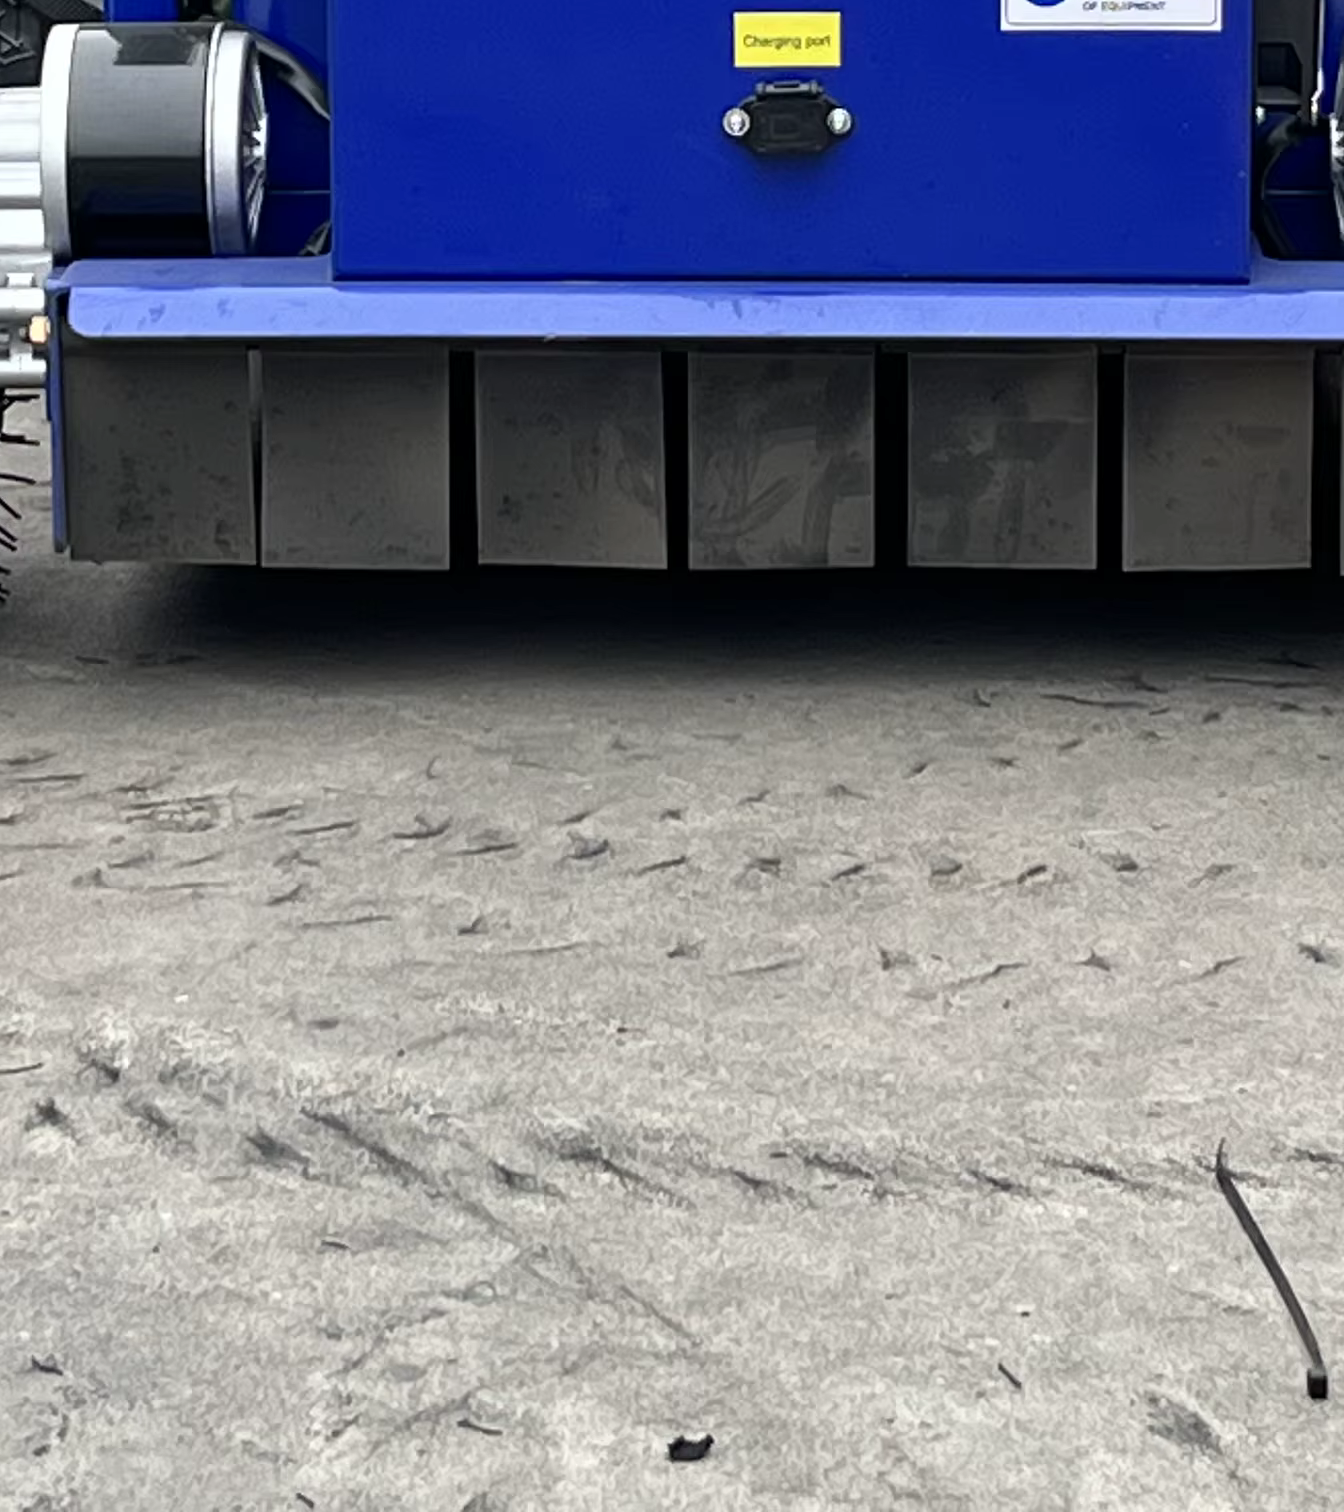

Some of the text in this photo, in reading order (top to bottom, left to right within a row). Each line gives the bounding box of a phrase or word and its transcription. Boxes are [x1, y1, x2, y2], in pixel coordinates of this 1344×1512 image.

[1083, 2, 1166, 11] OF EQUIPMENT
[743, 35, 831, 50] Charging port
